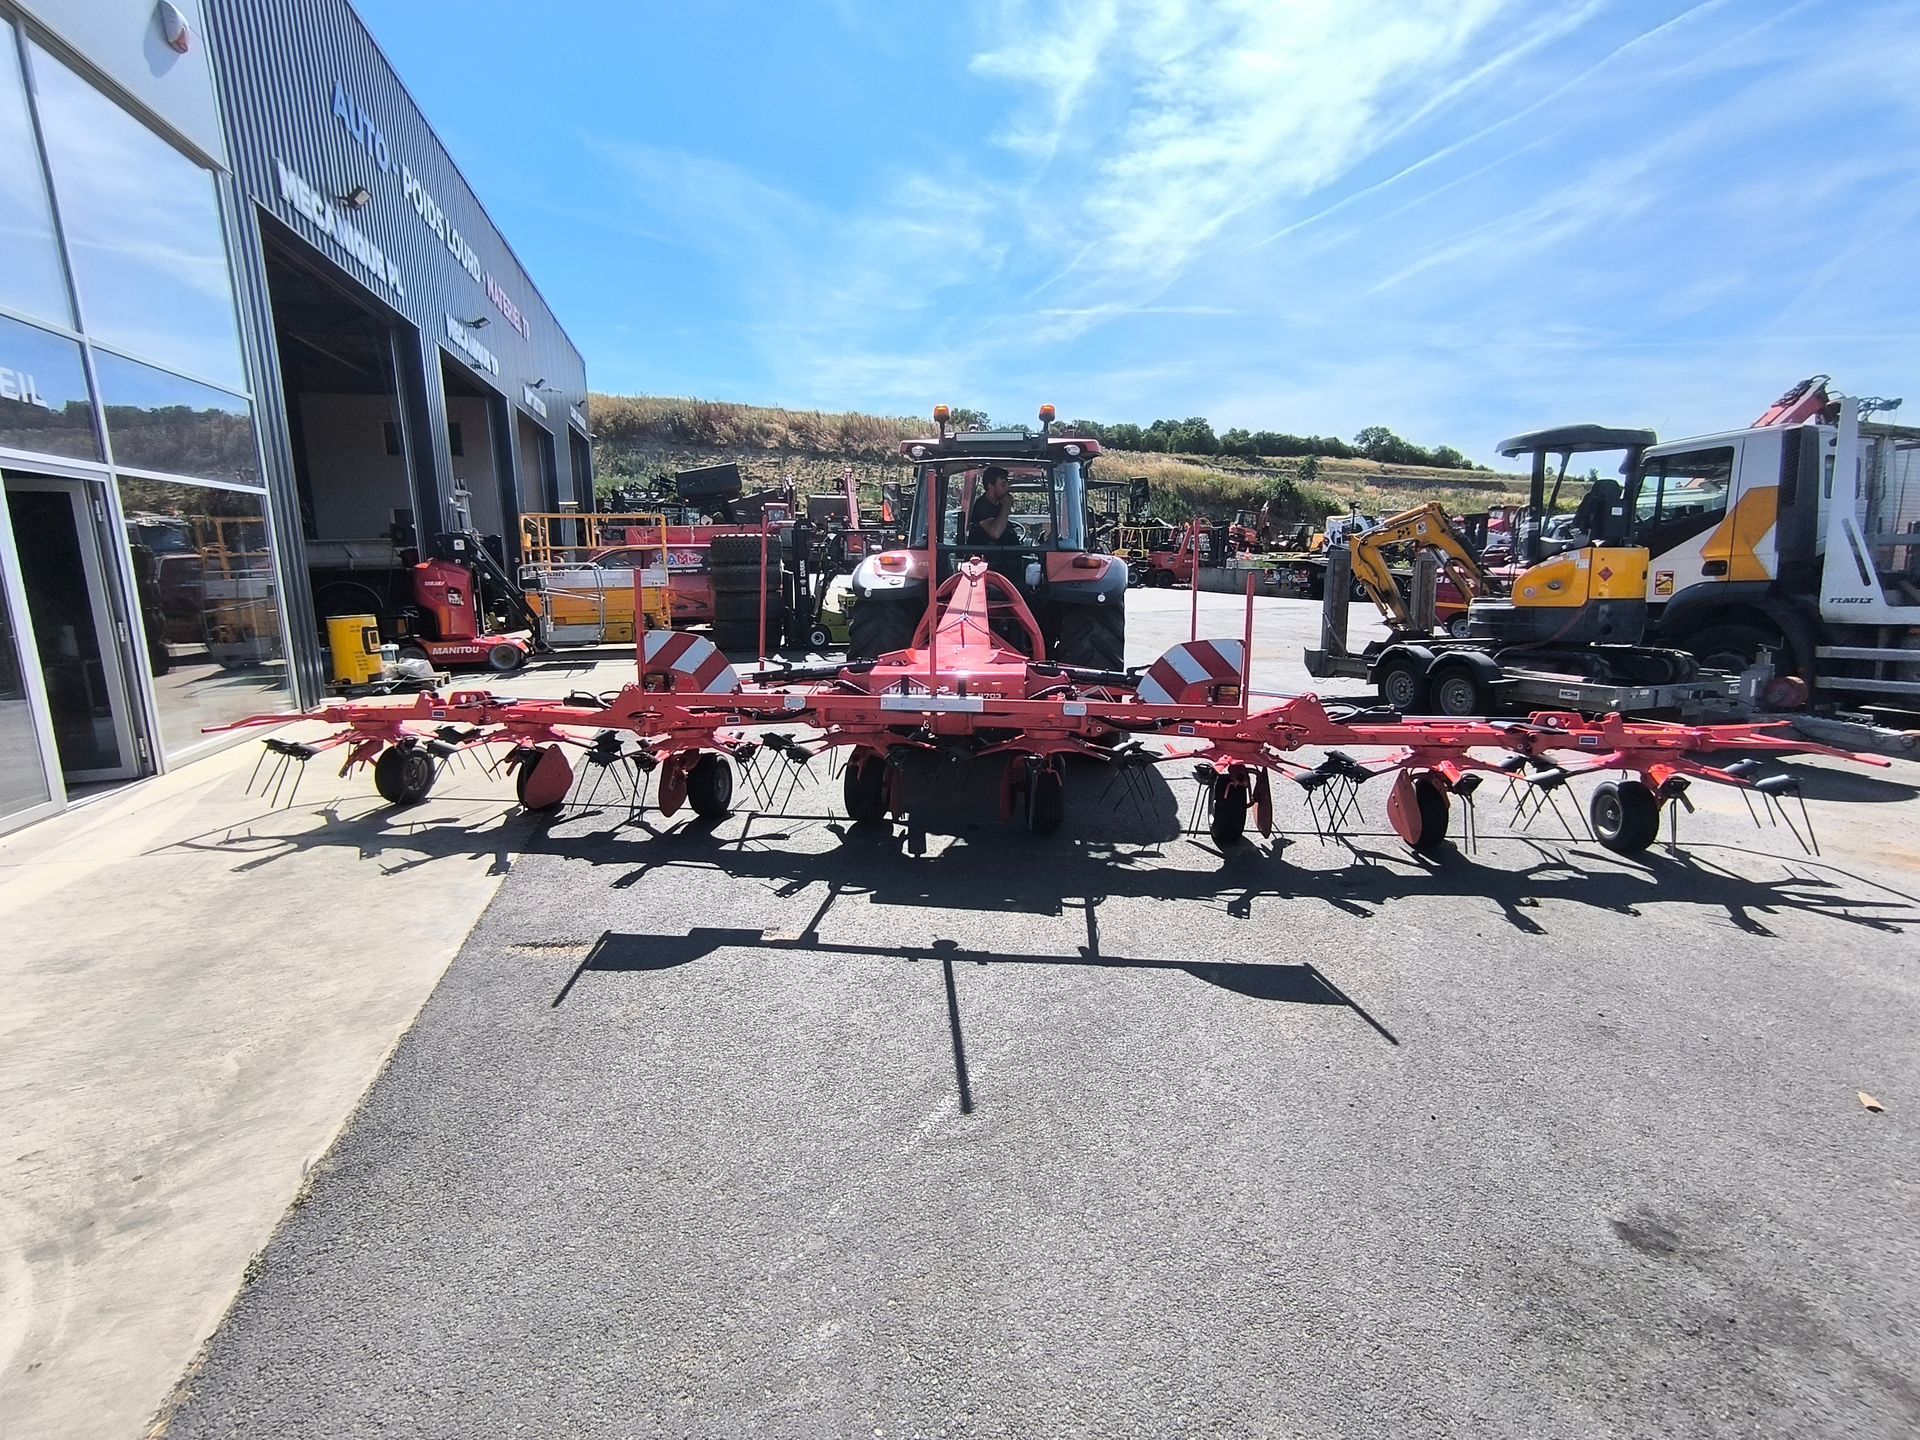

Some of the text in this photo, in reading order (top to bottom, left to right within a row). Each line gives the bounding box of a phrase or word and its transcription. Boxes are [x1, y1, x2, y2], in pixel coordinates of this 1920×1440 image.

[277, 157, 388, 285] MECANIQUE
[333, 79, 389, 174] AUTO
[402, 163, 445, 240] POIDS
[446, 218, 482, 283] LOURD
[432, 646, 479, 655] MANITOU
